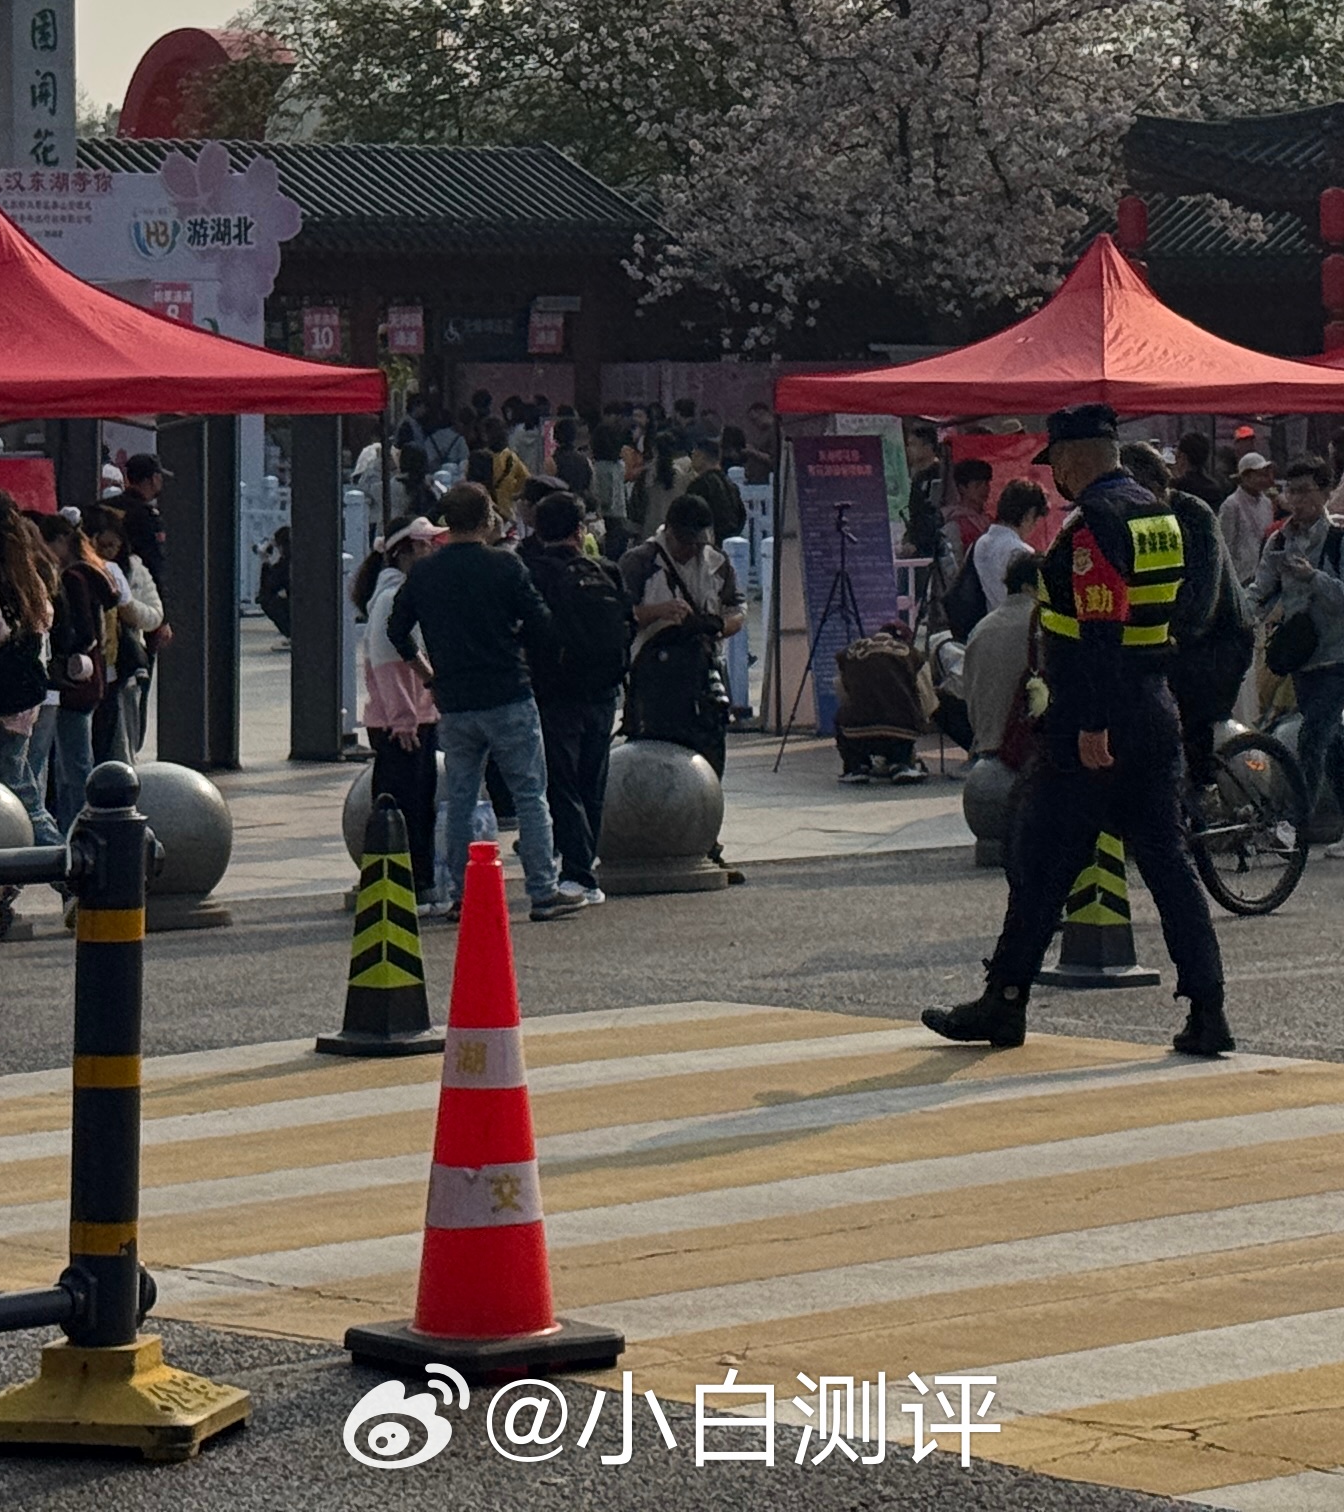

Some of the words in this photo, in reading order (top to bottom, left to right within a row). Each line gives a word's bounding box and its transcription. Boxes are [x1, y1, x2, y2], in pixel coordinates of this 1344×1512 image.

[186, 215, 255, 246] 游湖北
[310, 326, 334, 349] 10
